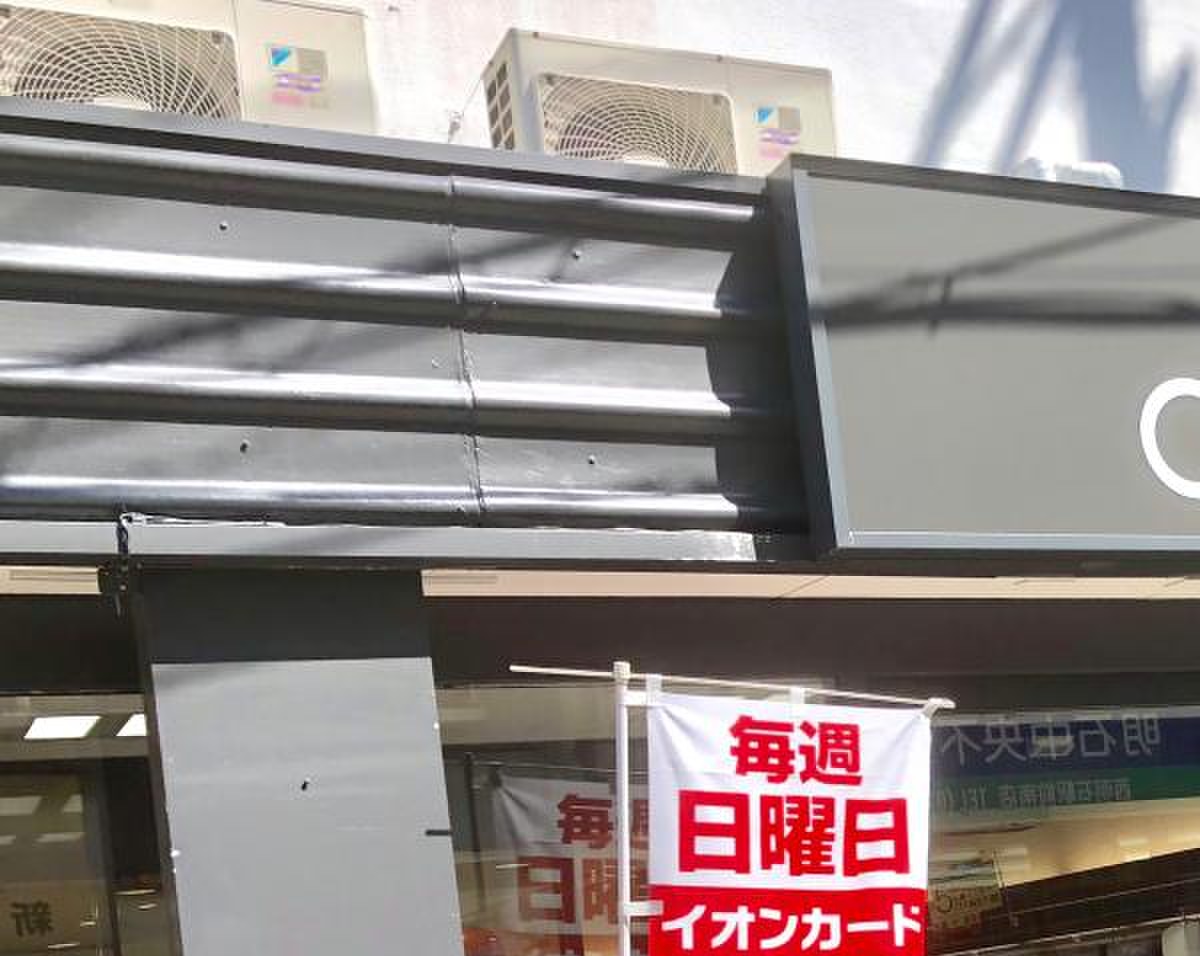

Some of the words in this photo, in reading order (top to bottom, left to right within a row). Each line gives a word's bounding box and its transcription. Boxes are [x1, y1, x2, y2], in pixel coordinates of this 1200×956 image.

[729, 715, 863, 787] 毎週
[678, 789, 911, 877] 日曜日
[661, 904, 922, 952] イオンカード
